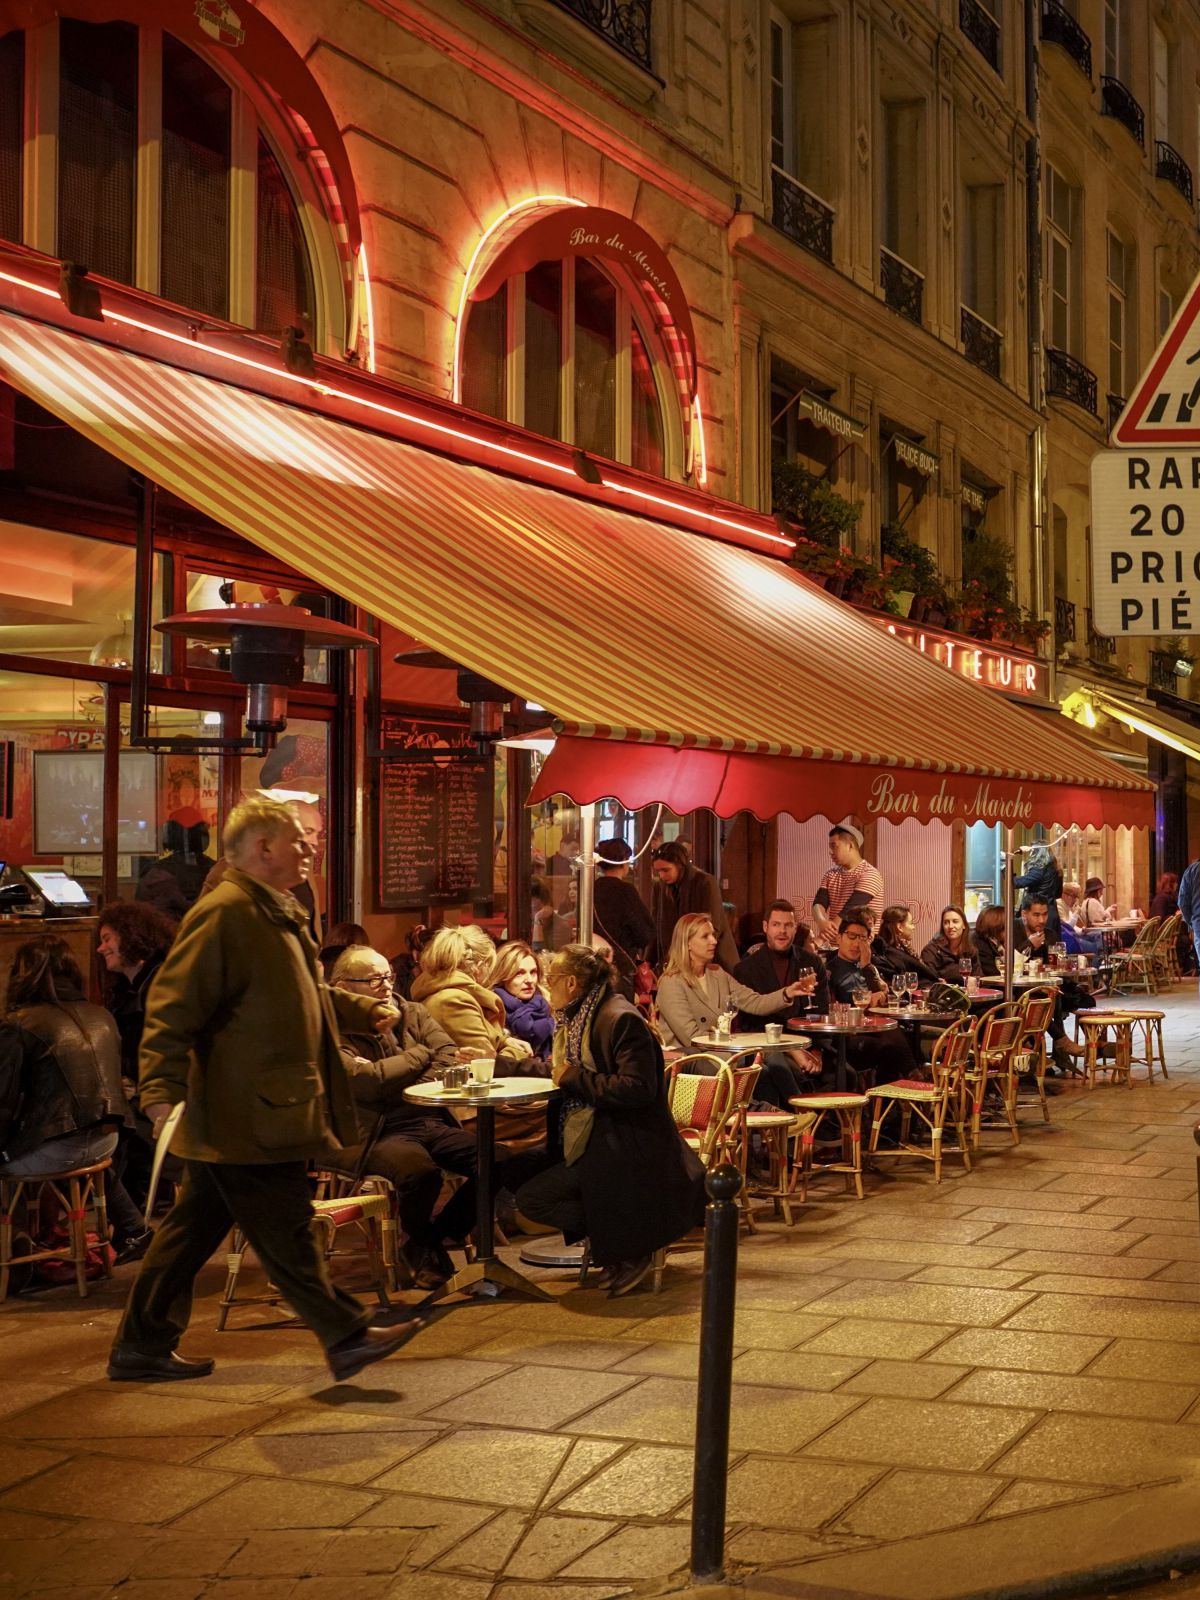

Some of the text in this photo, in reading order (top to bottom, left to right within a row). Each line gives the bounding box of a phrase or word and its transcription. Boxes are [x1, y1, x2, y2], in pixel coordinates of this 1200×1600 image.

[569, 227, 599, 246] Bar
[604, 233, 624, 251] du
[812, 401, 852, 437] TRAITEUR
[1130, 503, 1185, 537] 20
[867, 773, 1033, 818] Bar du Marché
